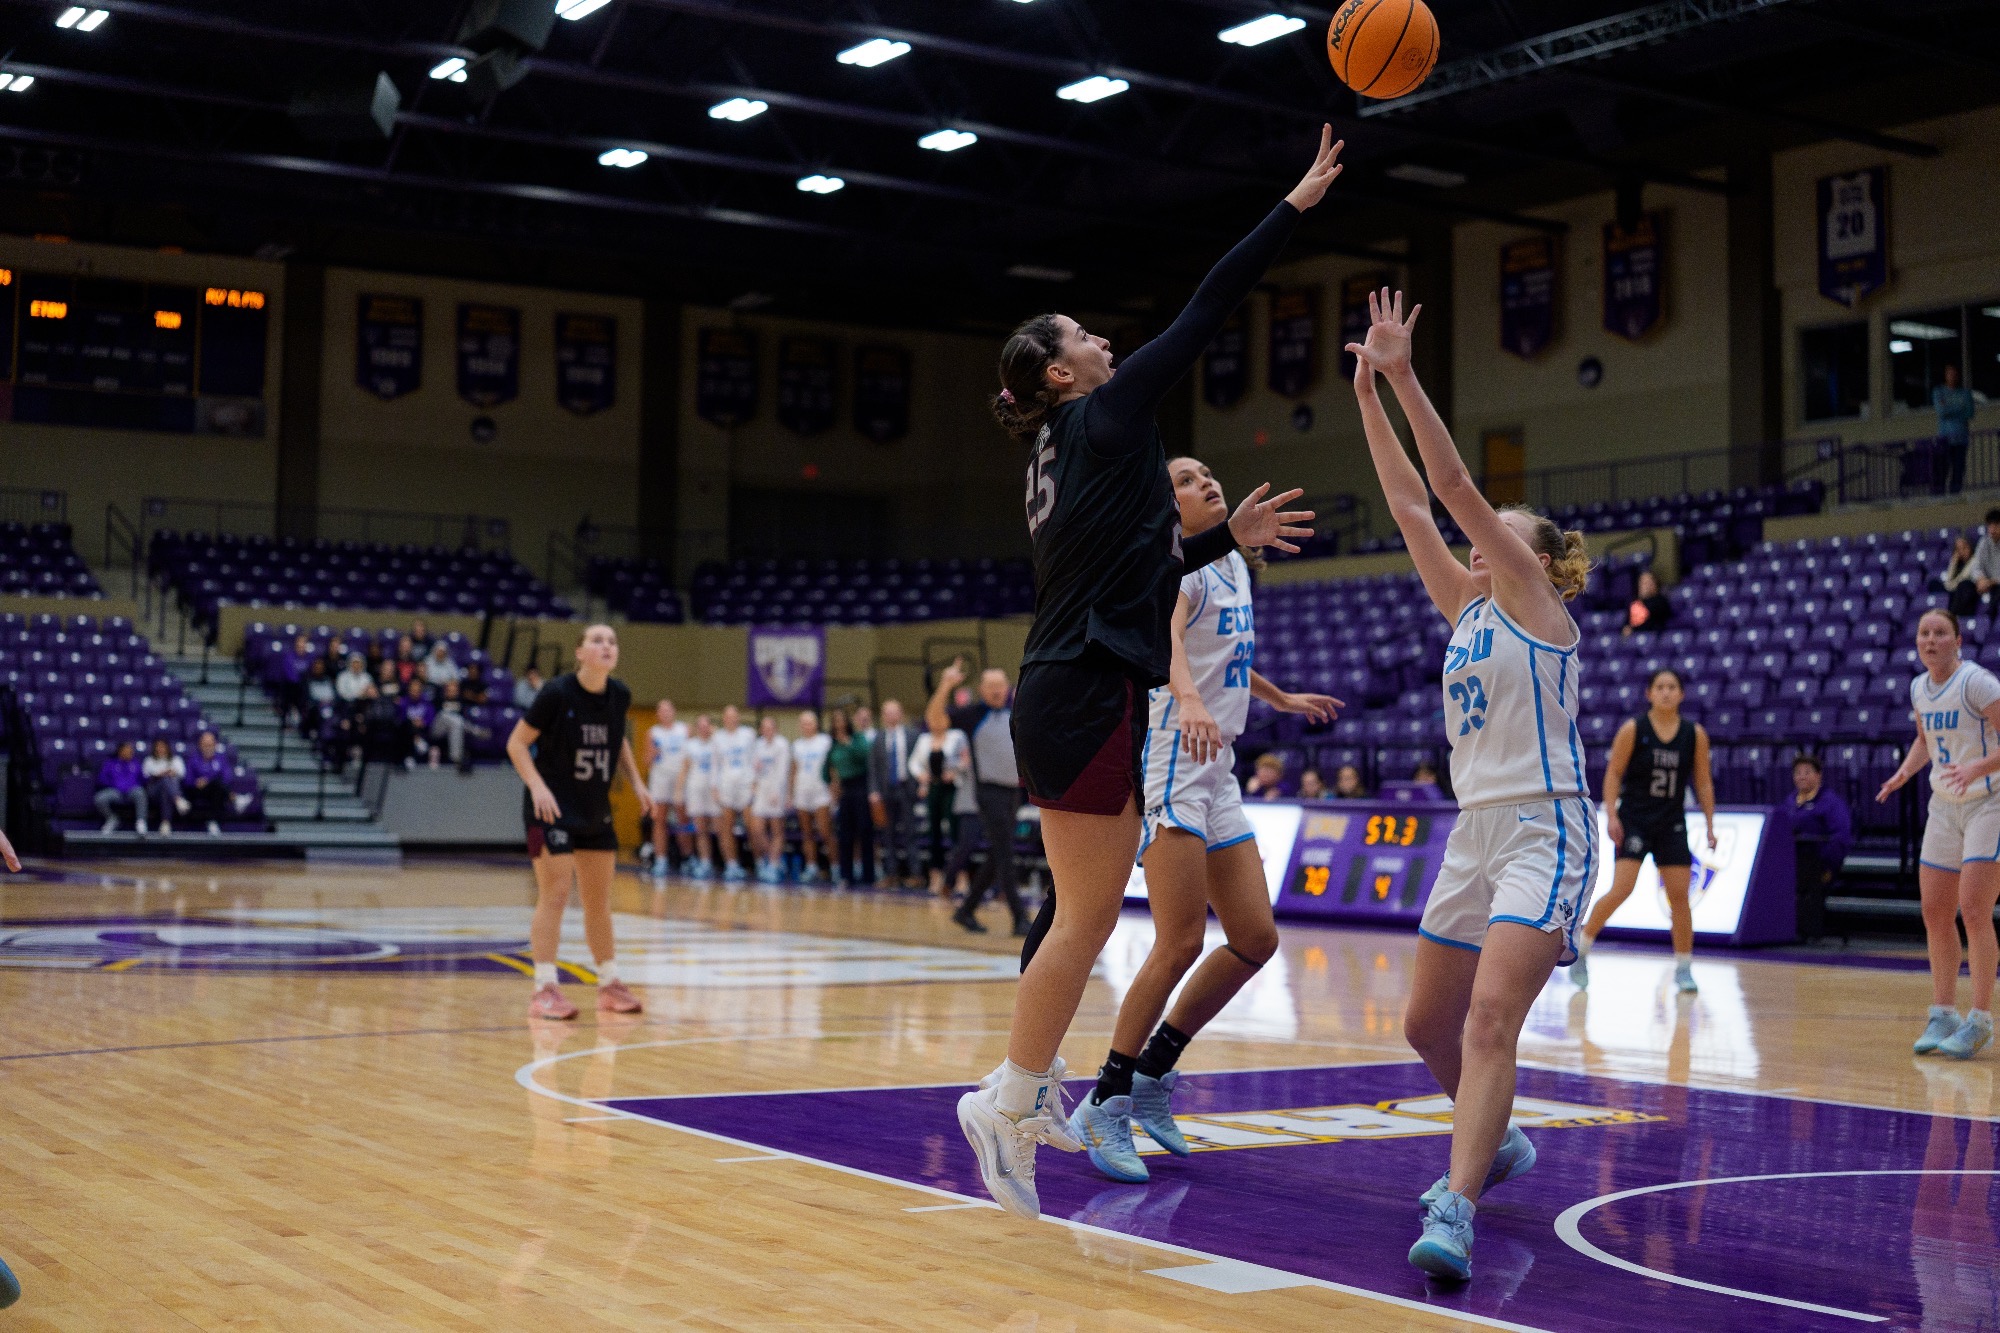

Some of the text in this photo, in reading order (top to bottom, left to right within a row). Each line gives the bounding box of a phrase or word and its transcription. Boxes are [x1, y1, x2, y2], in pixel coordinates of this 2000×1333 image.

[1331, 0, 1364, 50] NCAA
[1920, 709, 1960, 731] TBU
[574, 747, 611, 782] 54
[1936, 735, 1951, 764] 5
[1648, 767, 1679, 799] 21
[1364, 814, 1419, 847] 57.3
